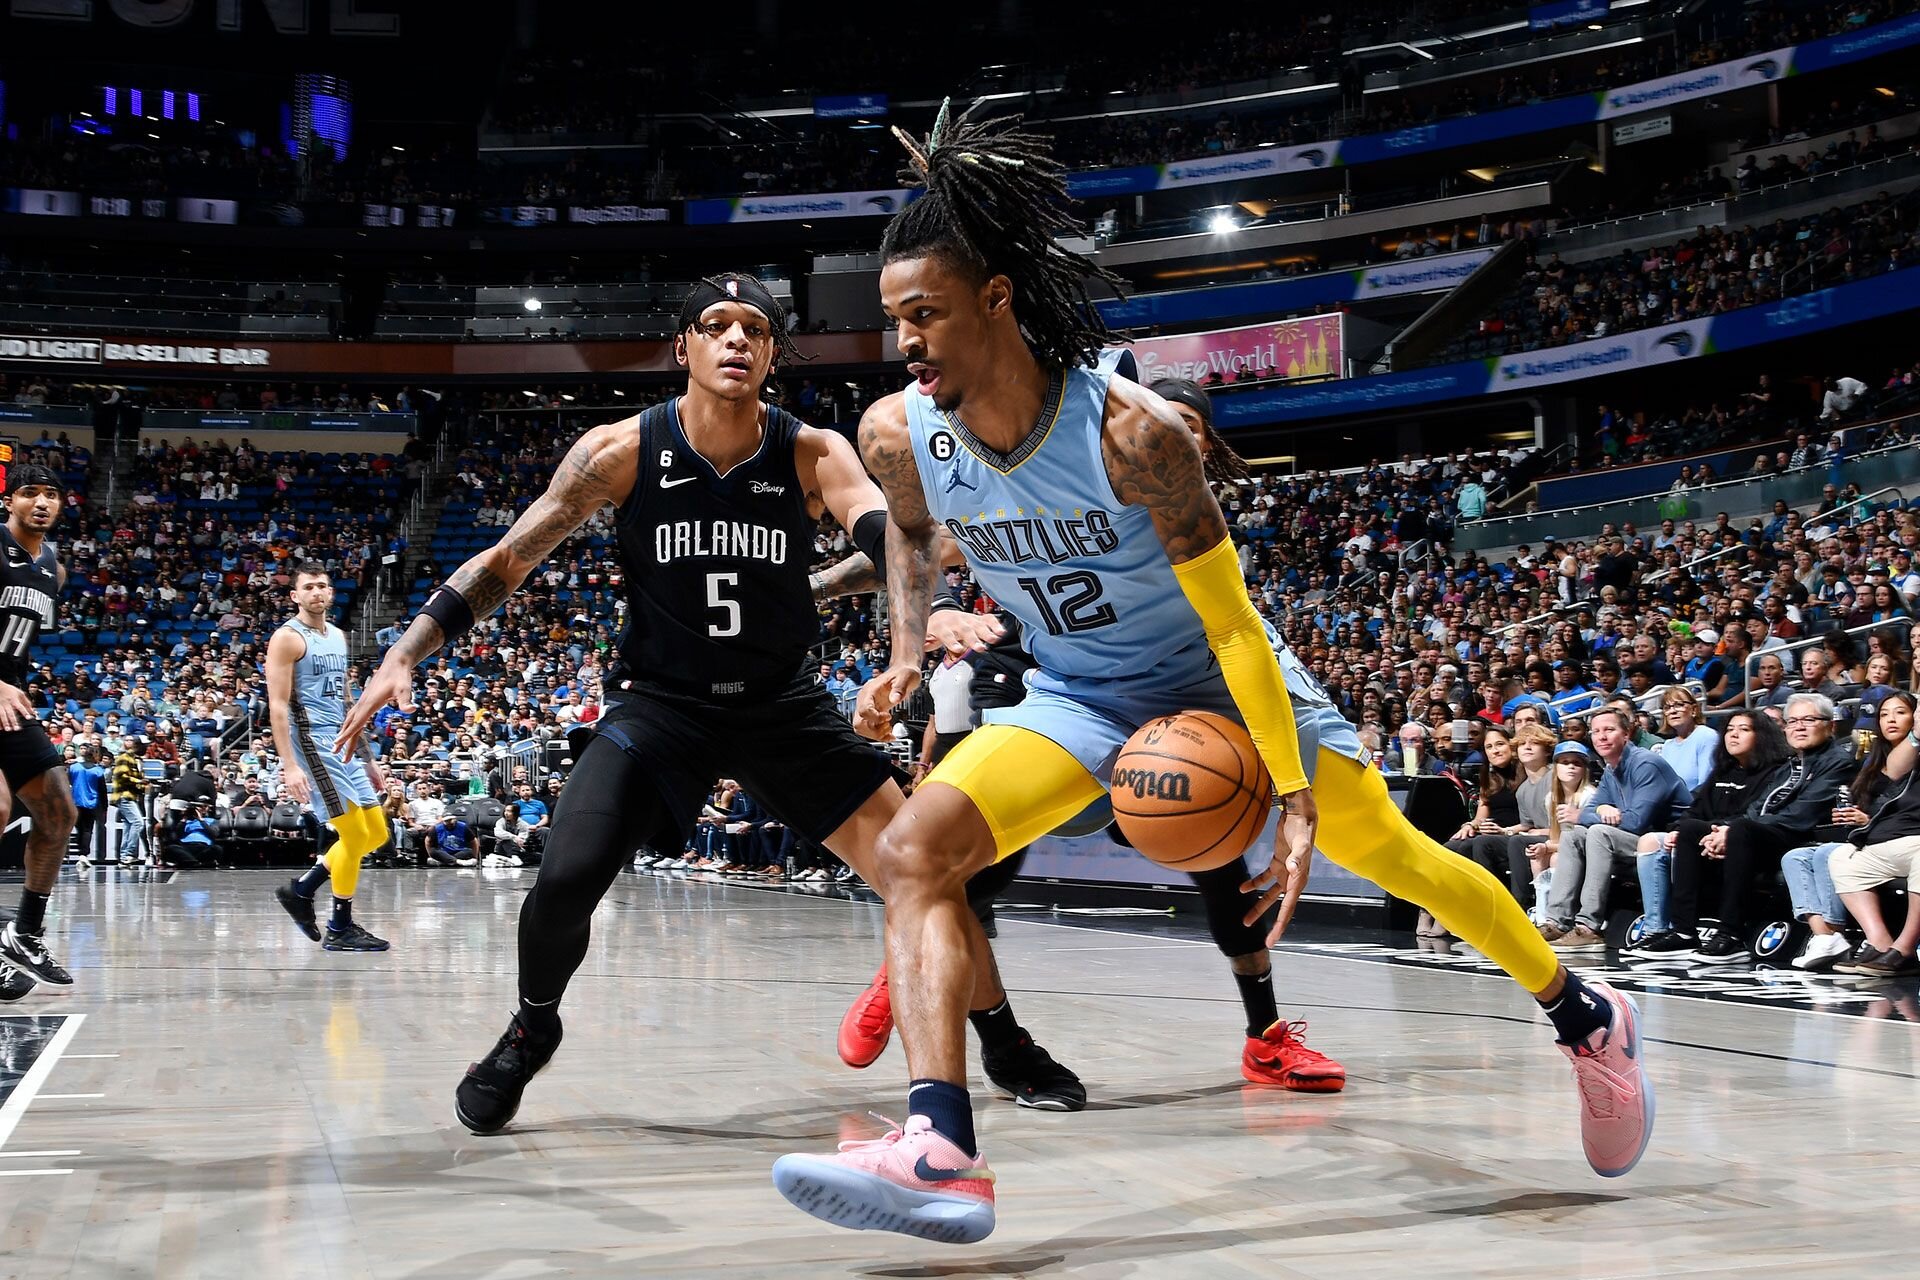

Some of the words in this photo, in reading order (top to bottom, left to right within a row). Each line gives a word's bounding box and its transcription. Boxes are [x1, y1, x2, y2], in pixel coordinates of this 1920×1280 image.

[1627, 75, 1722, 105] AdventHealth
[1186, 158, 1275, 178] AdventHealth
[758, 201, 845, 215] AdventHealth
[28, 340, 100, 359] LIGHT
[105, 343, 218, 364] BASELINE
[220, 348, 270, 365] BAR
[1208, 343, 1279, 374] World
[1523, 345, 1633, 377] AdventHealth
[660, 450, 673, 467] 6
[935, 435, 950, 459] 6
[656, 520, 787, 565] ORLANDO
[946, 510, 1119, 565] GRIZZLIES
[706, 572, 742, 637] 5
[1017, 570, 1119, 637] 12
[0, 614, 35, 657] 14
[1112, 766, 1193, 803] Wilson
